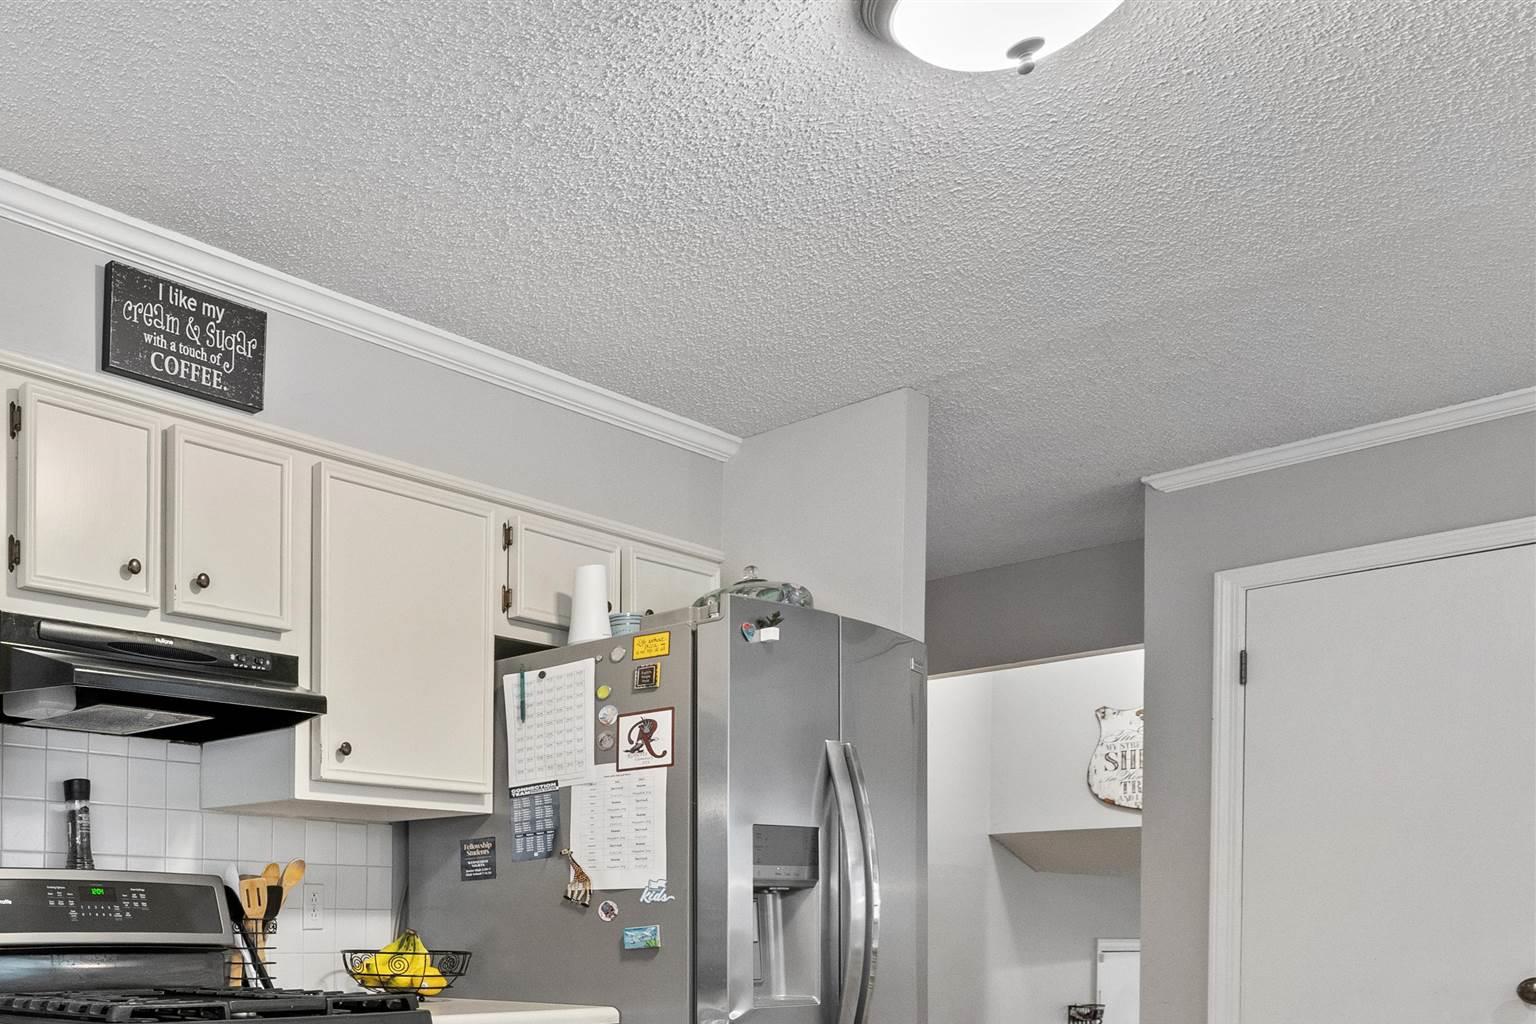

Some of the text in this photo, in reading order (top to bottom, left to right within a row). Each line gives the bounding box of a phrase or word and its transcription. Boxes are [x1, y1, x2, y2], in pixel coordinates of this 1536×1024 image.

[123, 300, 181, 335] cream
[186, 316, 201, 345] &
[159, 283, 225, 324] I like my
[144, 331, 221, 366] with a touch of
[151, 351, 229, 391] COFFEE.
[511, 783, 556, 793] CONNECTION
